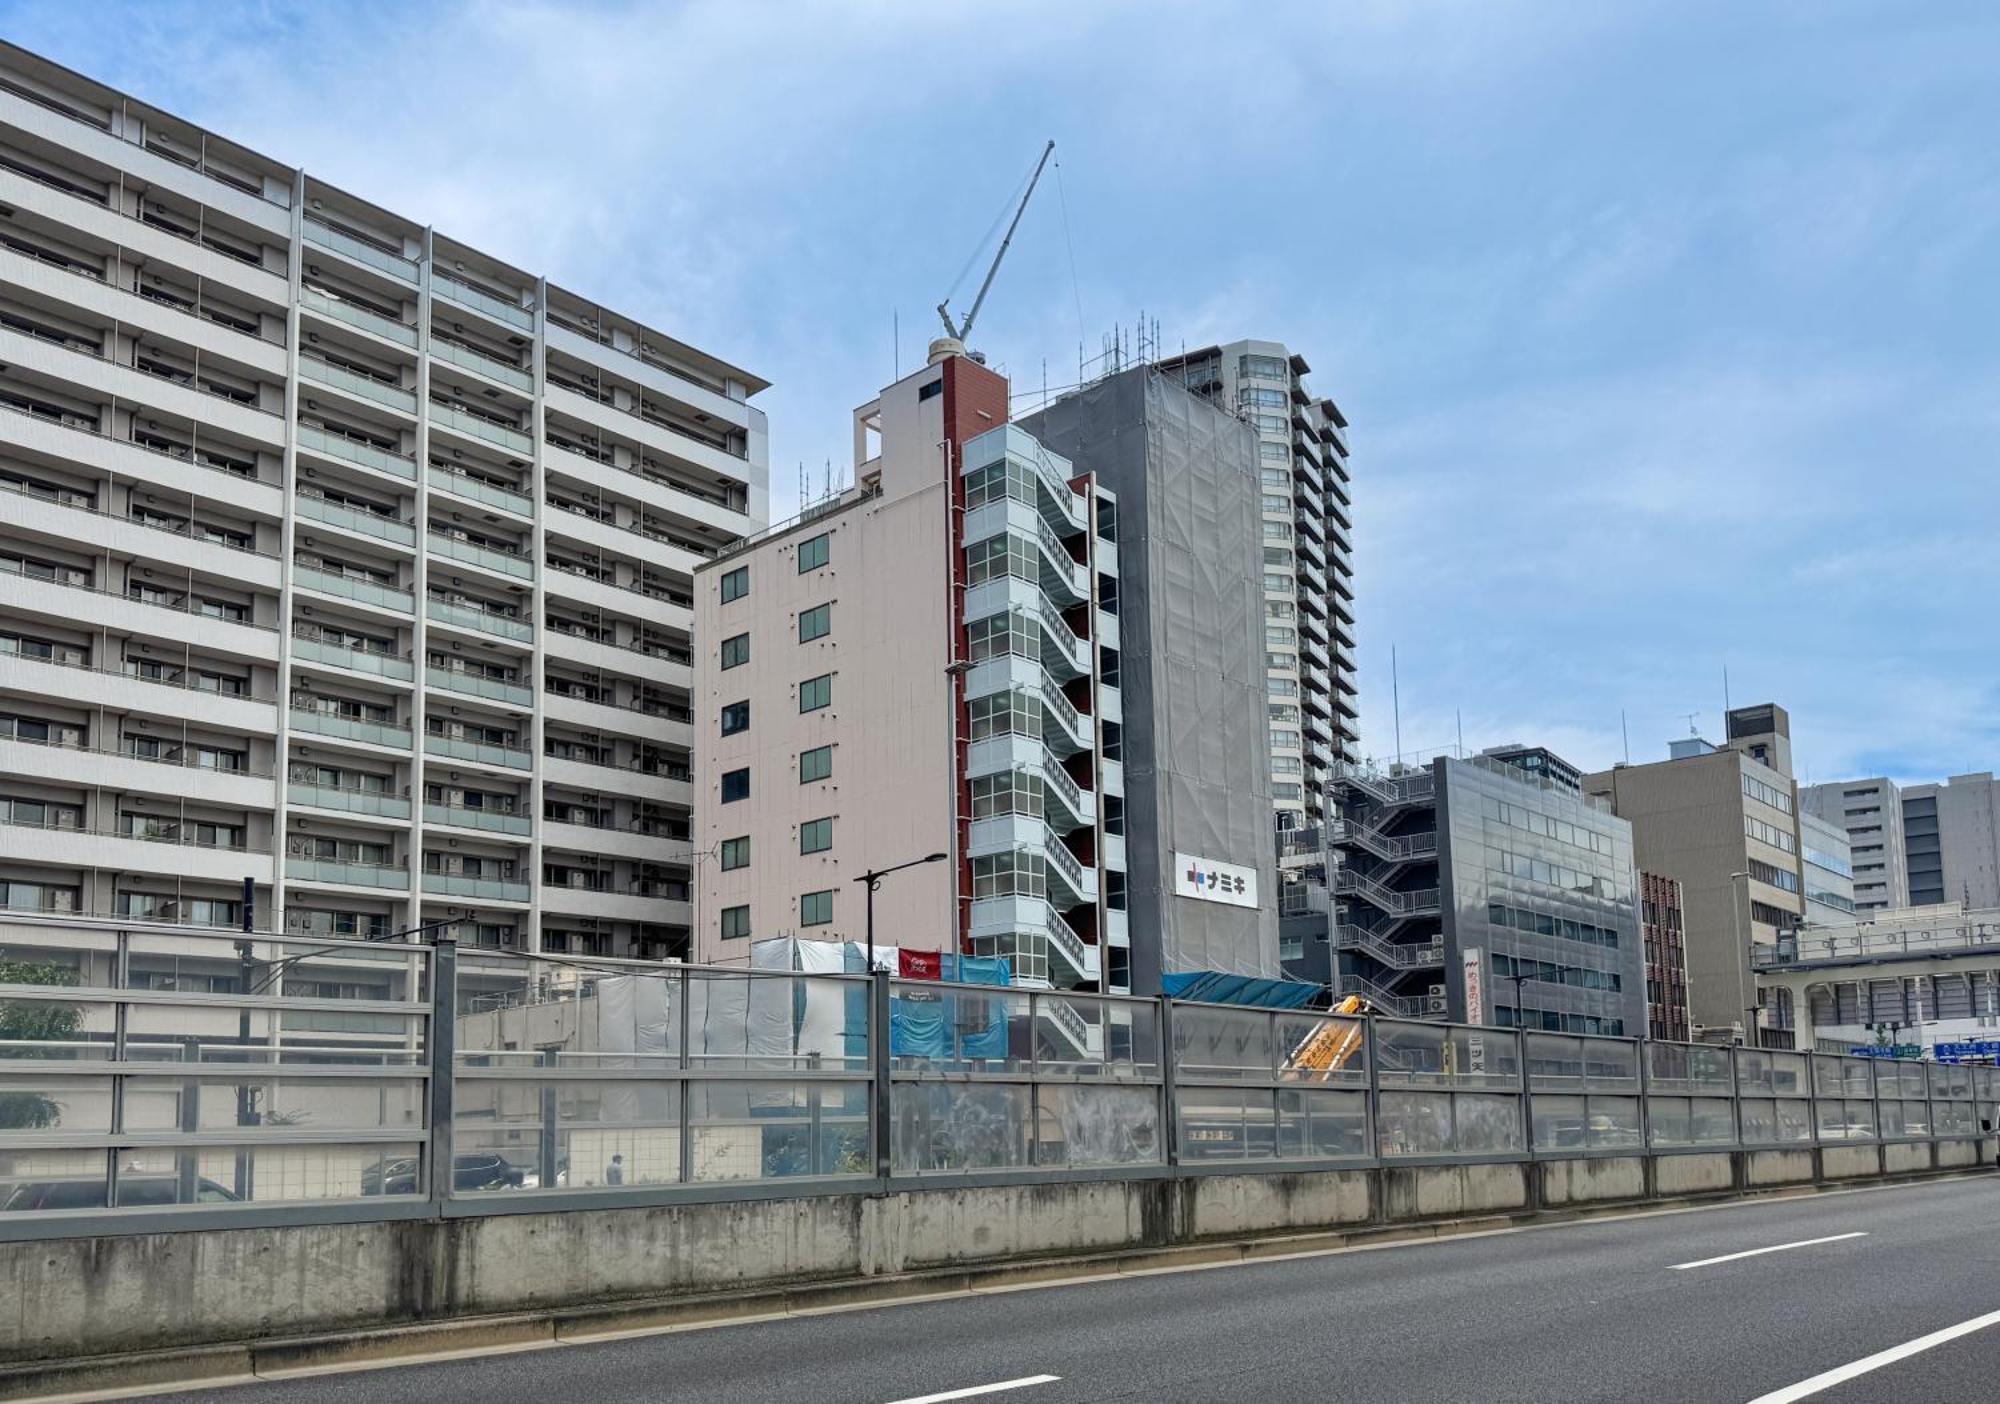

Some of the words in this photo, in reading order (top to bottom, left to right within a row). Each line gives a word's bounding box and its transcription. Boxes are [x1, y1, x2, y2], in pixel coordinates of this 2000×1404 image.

[1207, 871, 1245, 895] ナミキ
[1467, 971, 1480, 1024] めっきのパイオ
